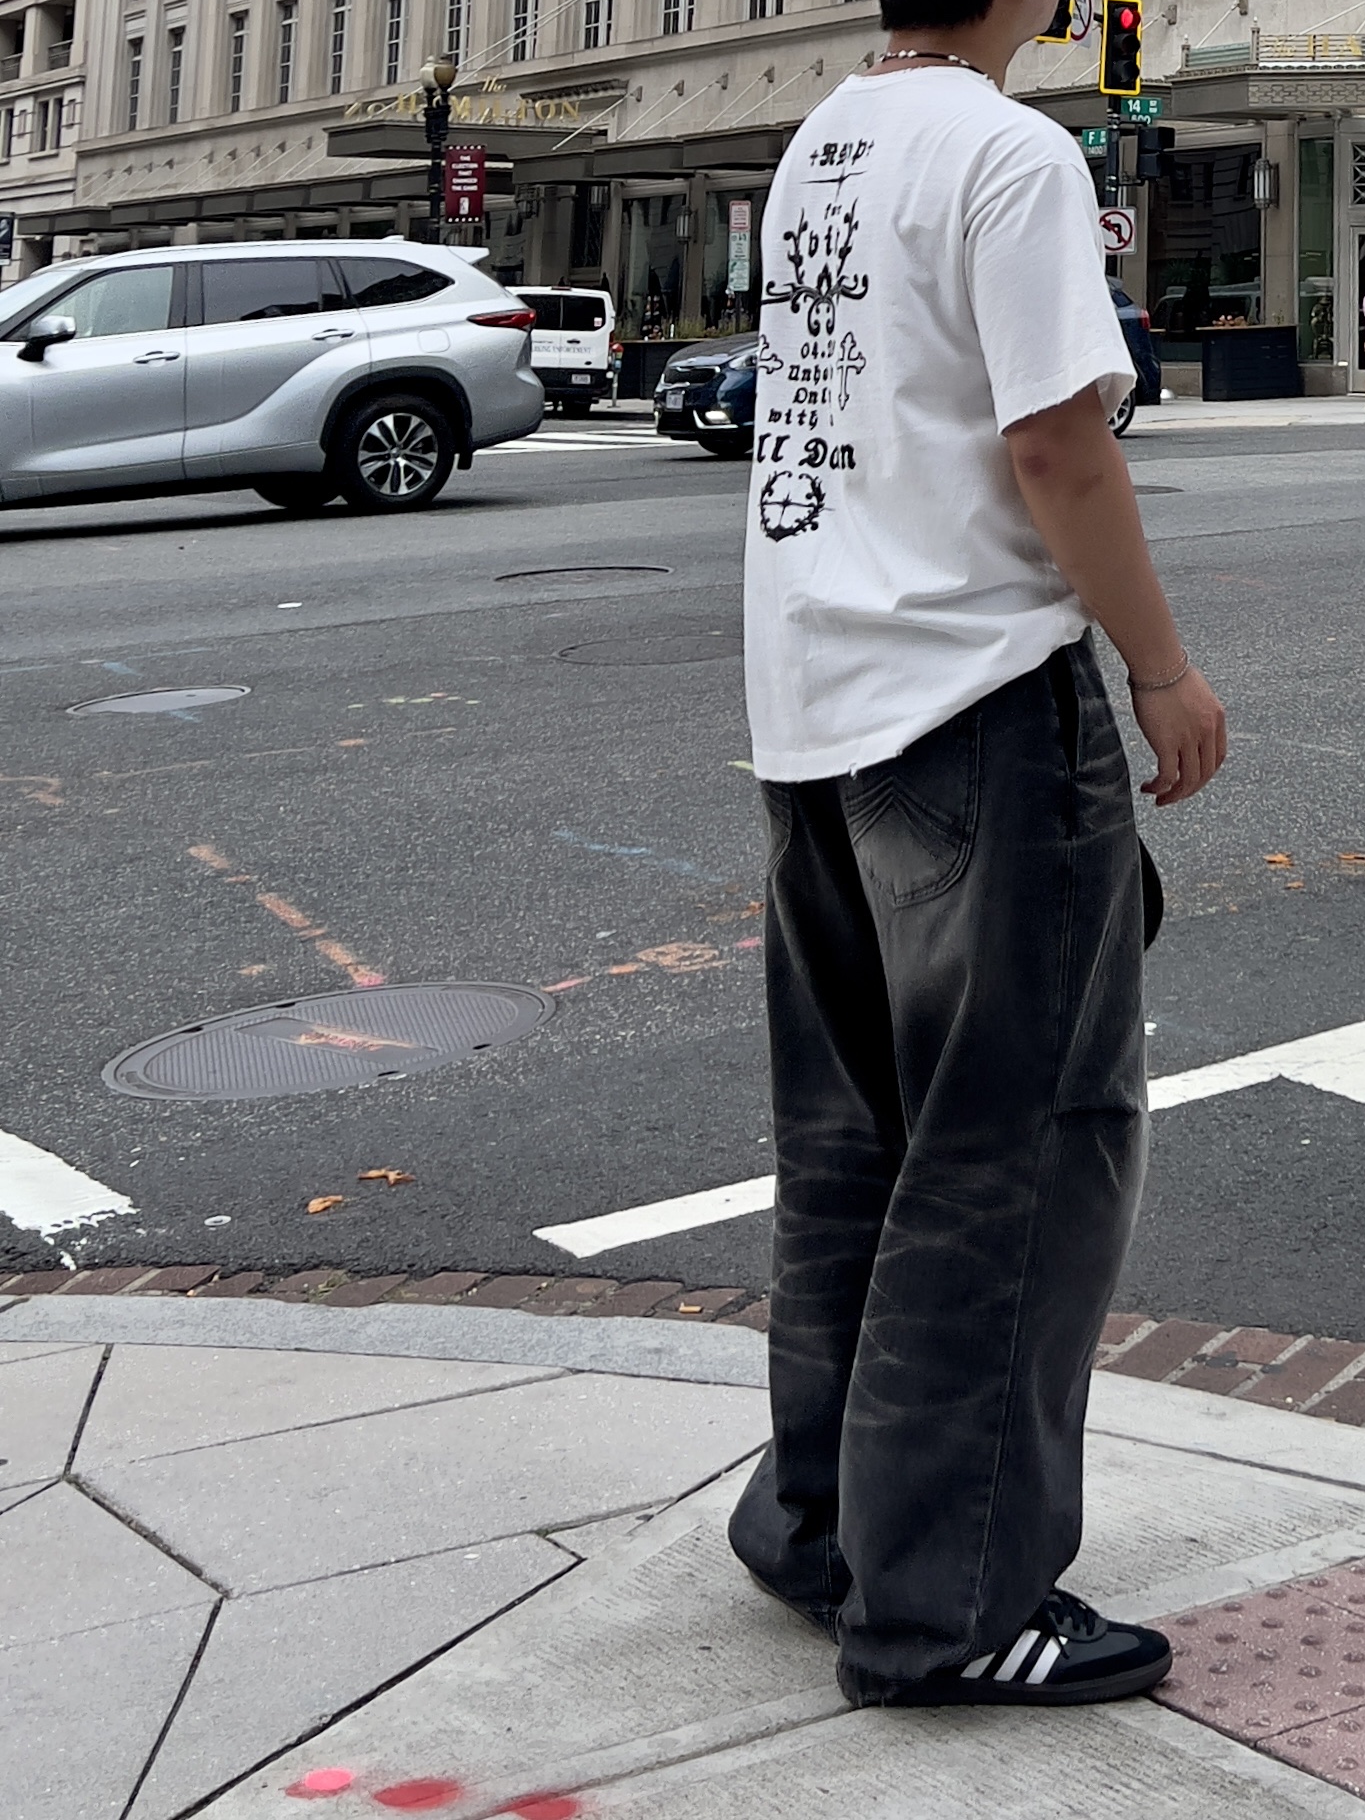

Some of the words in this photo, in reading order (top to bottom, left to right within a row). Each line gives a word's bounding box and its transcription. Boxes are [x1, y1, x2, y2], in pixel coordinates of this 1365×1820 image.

[478, 74, 507, 93] The
[1127, 99, 1141, 113] 14
[1088, 131, 1096, 145] F
